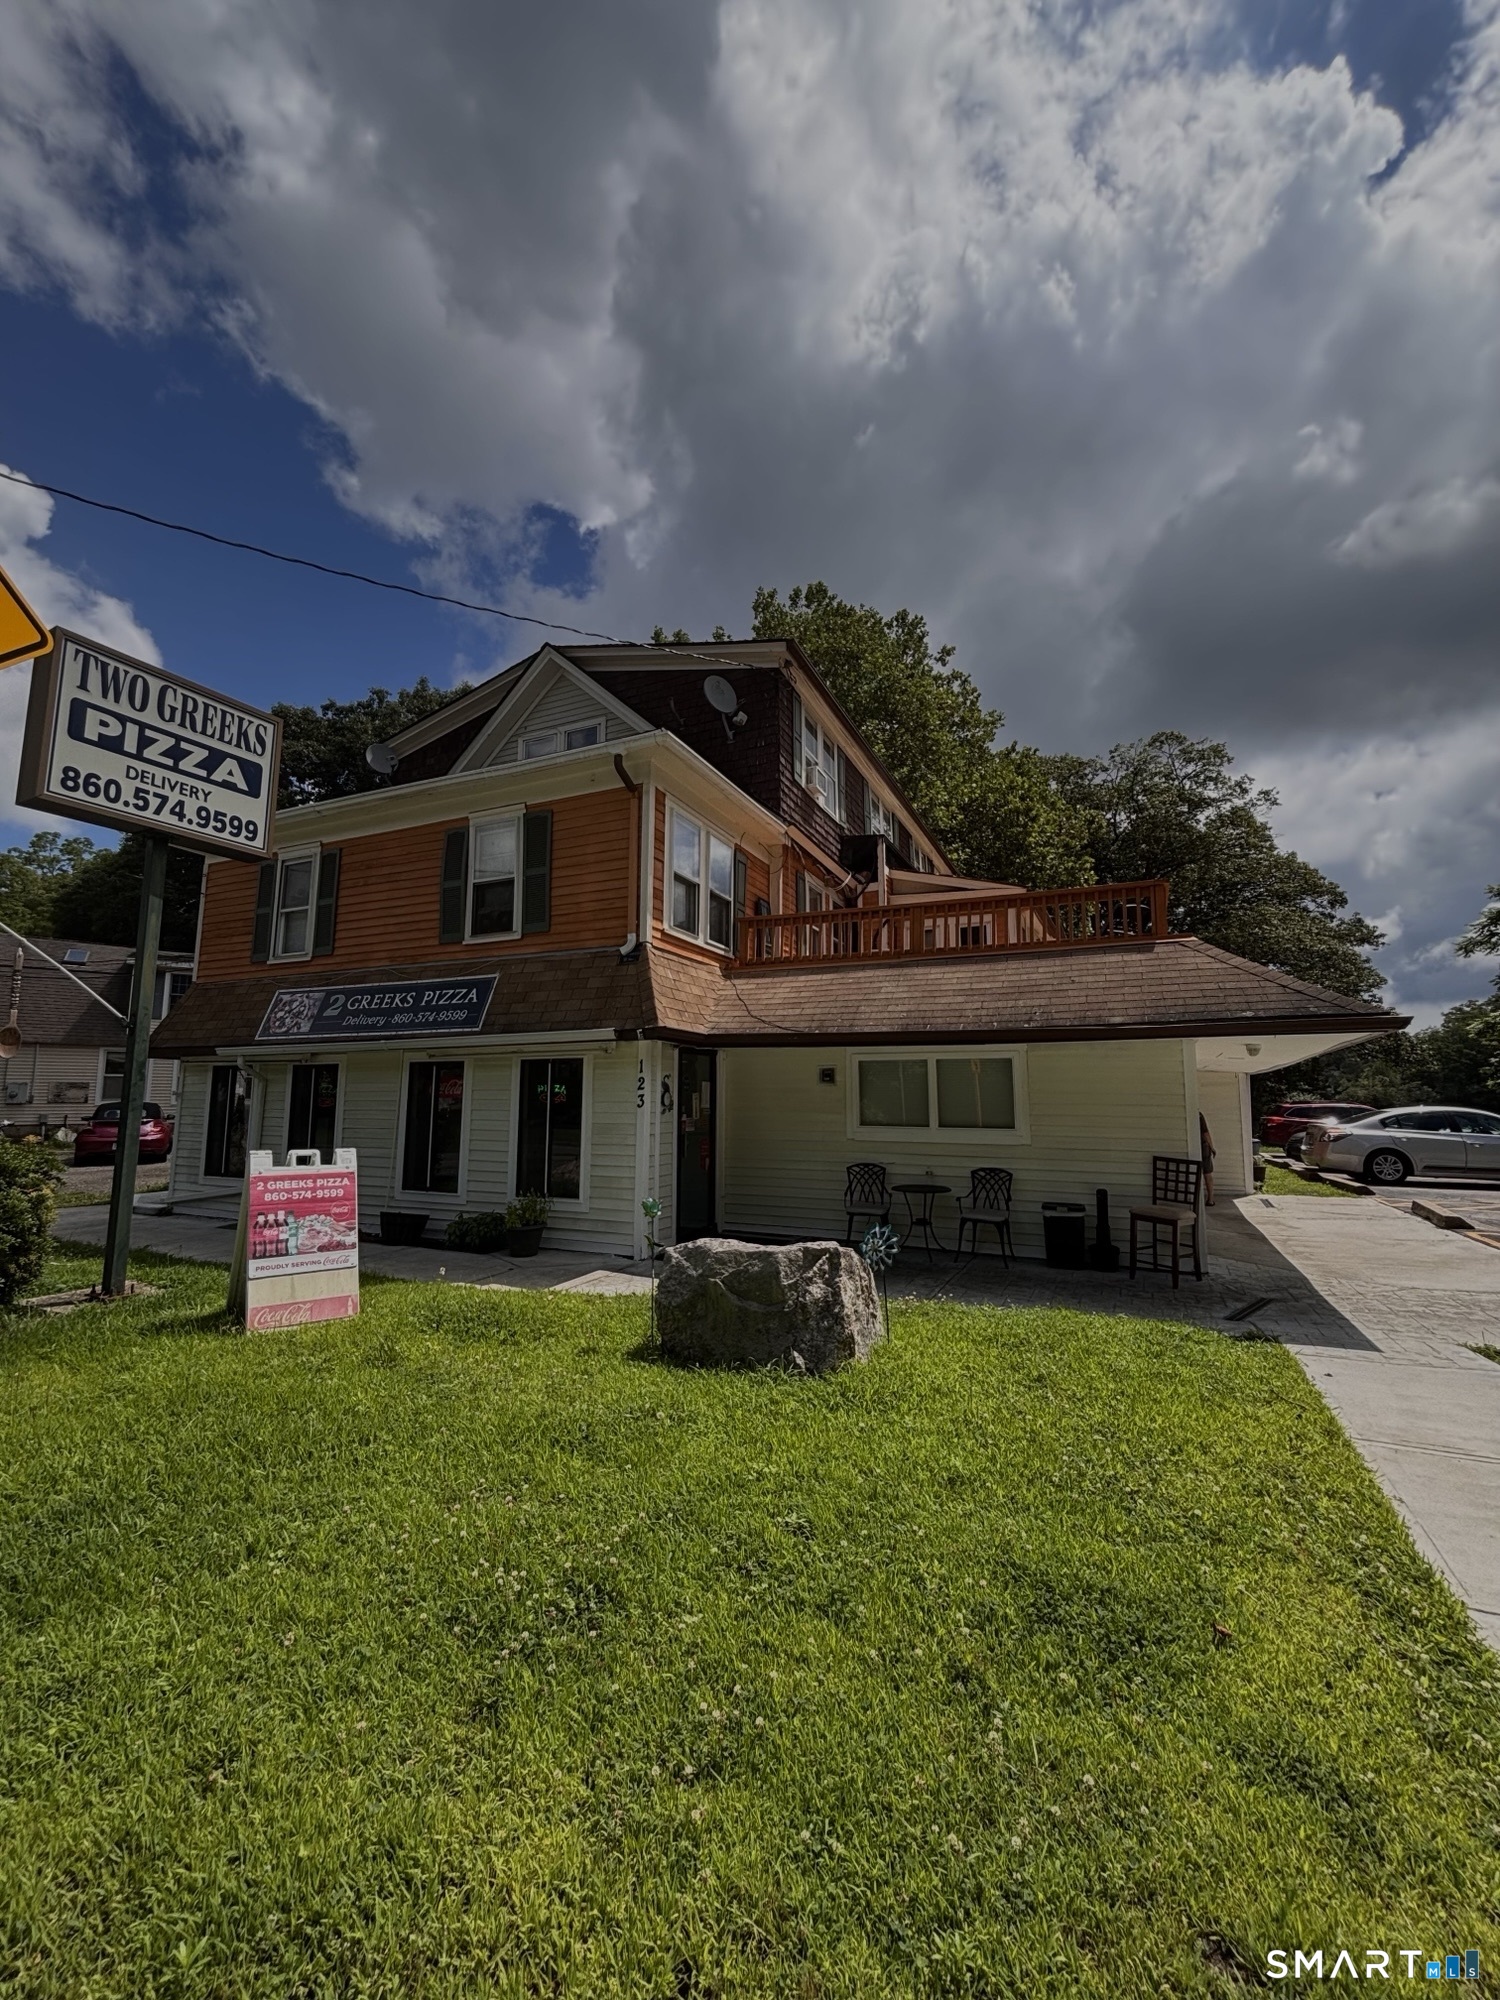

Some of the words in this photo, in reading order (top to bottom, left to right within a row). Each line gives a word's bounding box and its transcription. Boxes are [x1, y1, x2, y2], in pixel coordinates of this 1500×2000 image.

[74, 648, 150, 713] TWO
[156, 683, 268, 757] GREEKS
[83, 707, 249, 792] PIZZA
[125, 764, 213, 803] DELIVERY
[60, 765, 258, 842] 860.574.9599
[322, 994, 347, 1017] 2
[347, 992, 417, 1010] GREEKS
[419, 988, 478, 1006] PIZZA
[342, 1014, 387, 1026] Delivery
[537, 1084, 567, 1094] PIZA
[256, 1181, 265, 1190] 2
[266, 1178, 314, 1190] GREEKS
[316, 1177, 350, 1187] PIZZA
[264, 1188, 344, 1201] 860-574-9599
[255, 1262, 289, 1272] PROUDLY
[290, 1259, 322, 1268] SERVING
[254, 1302, 314, 1328] Coca-Cola
